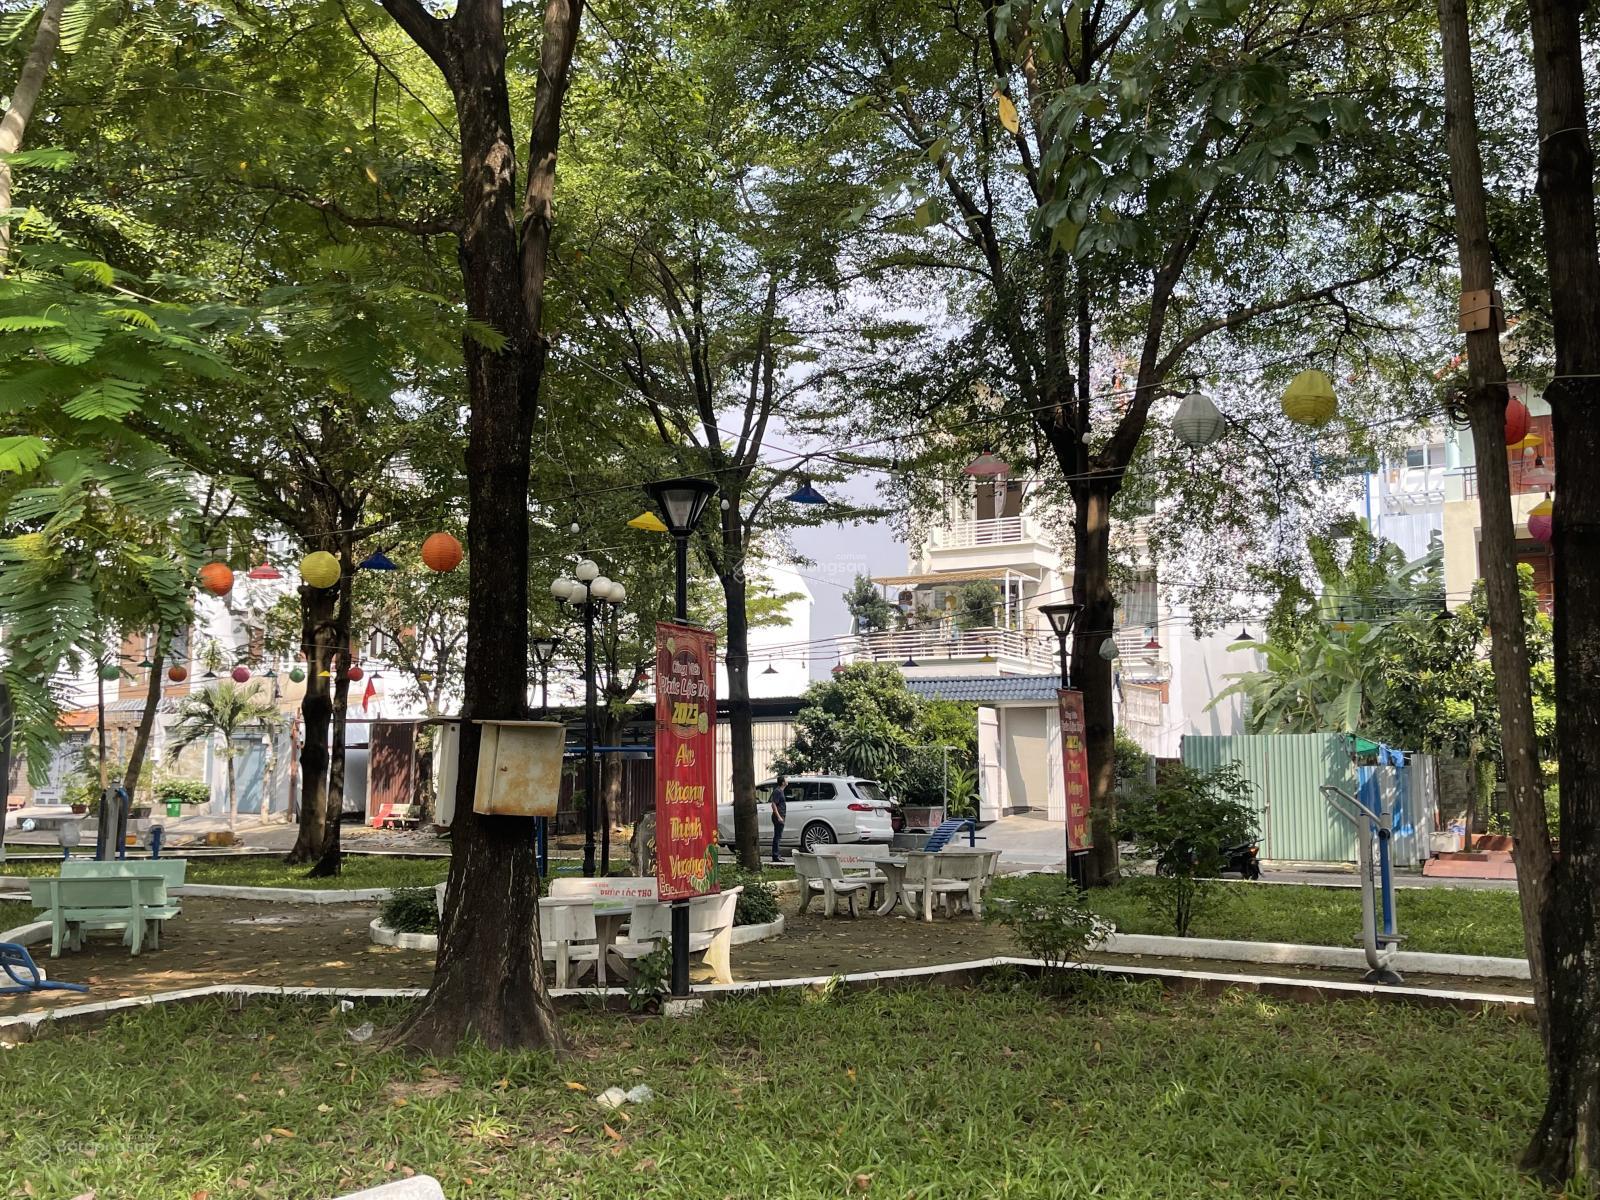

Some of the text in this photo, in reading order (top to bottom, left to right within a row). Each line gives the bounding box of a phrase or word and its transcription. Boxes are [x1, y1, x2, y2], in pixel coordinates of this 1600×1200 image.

[659, 674, 681, 696] Phúc
[680, 678, 697, 699] Lộc
[672, 702, 699, 725] 2023
[675, 743, 695, 767] An
[665, 780, 705, 807] Khang
[670, 816, 703, 845] Thịnh
[669, 855, 706, 881] Vượng
